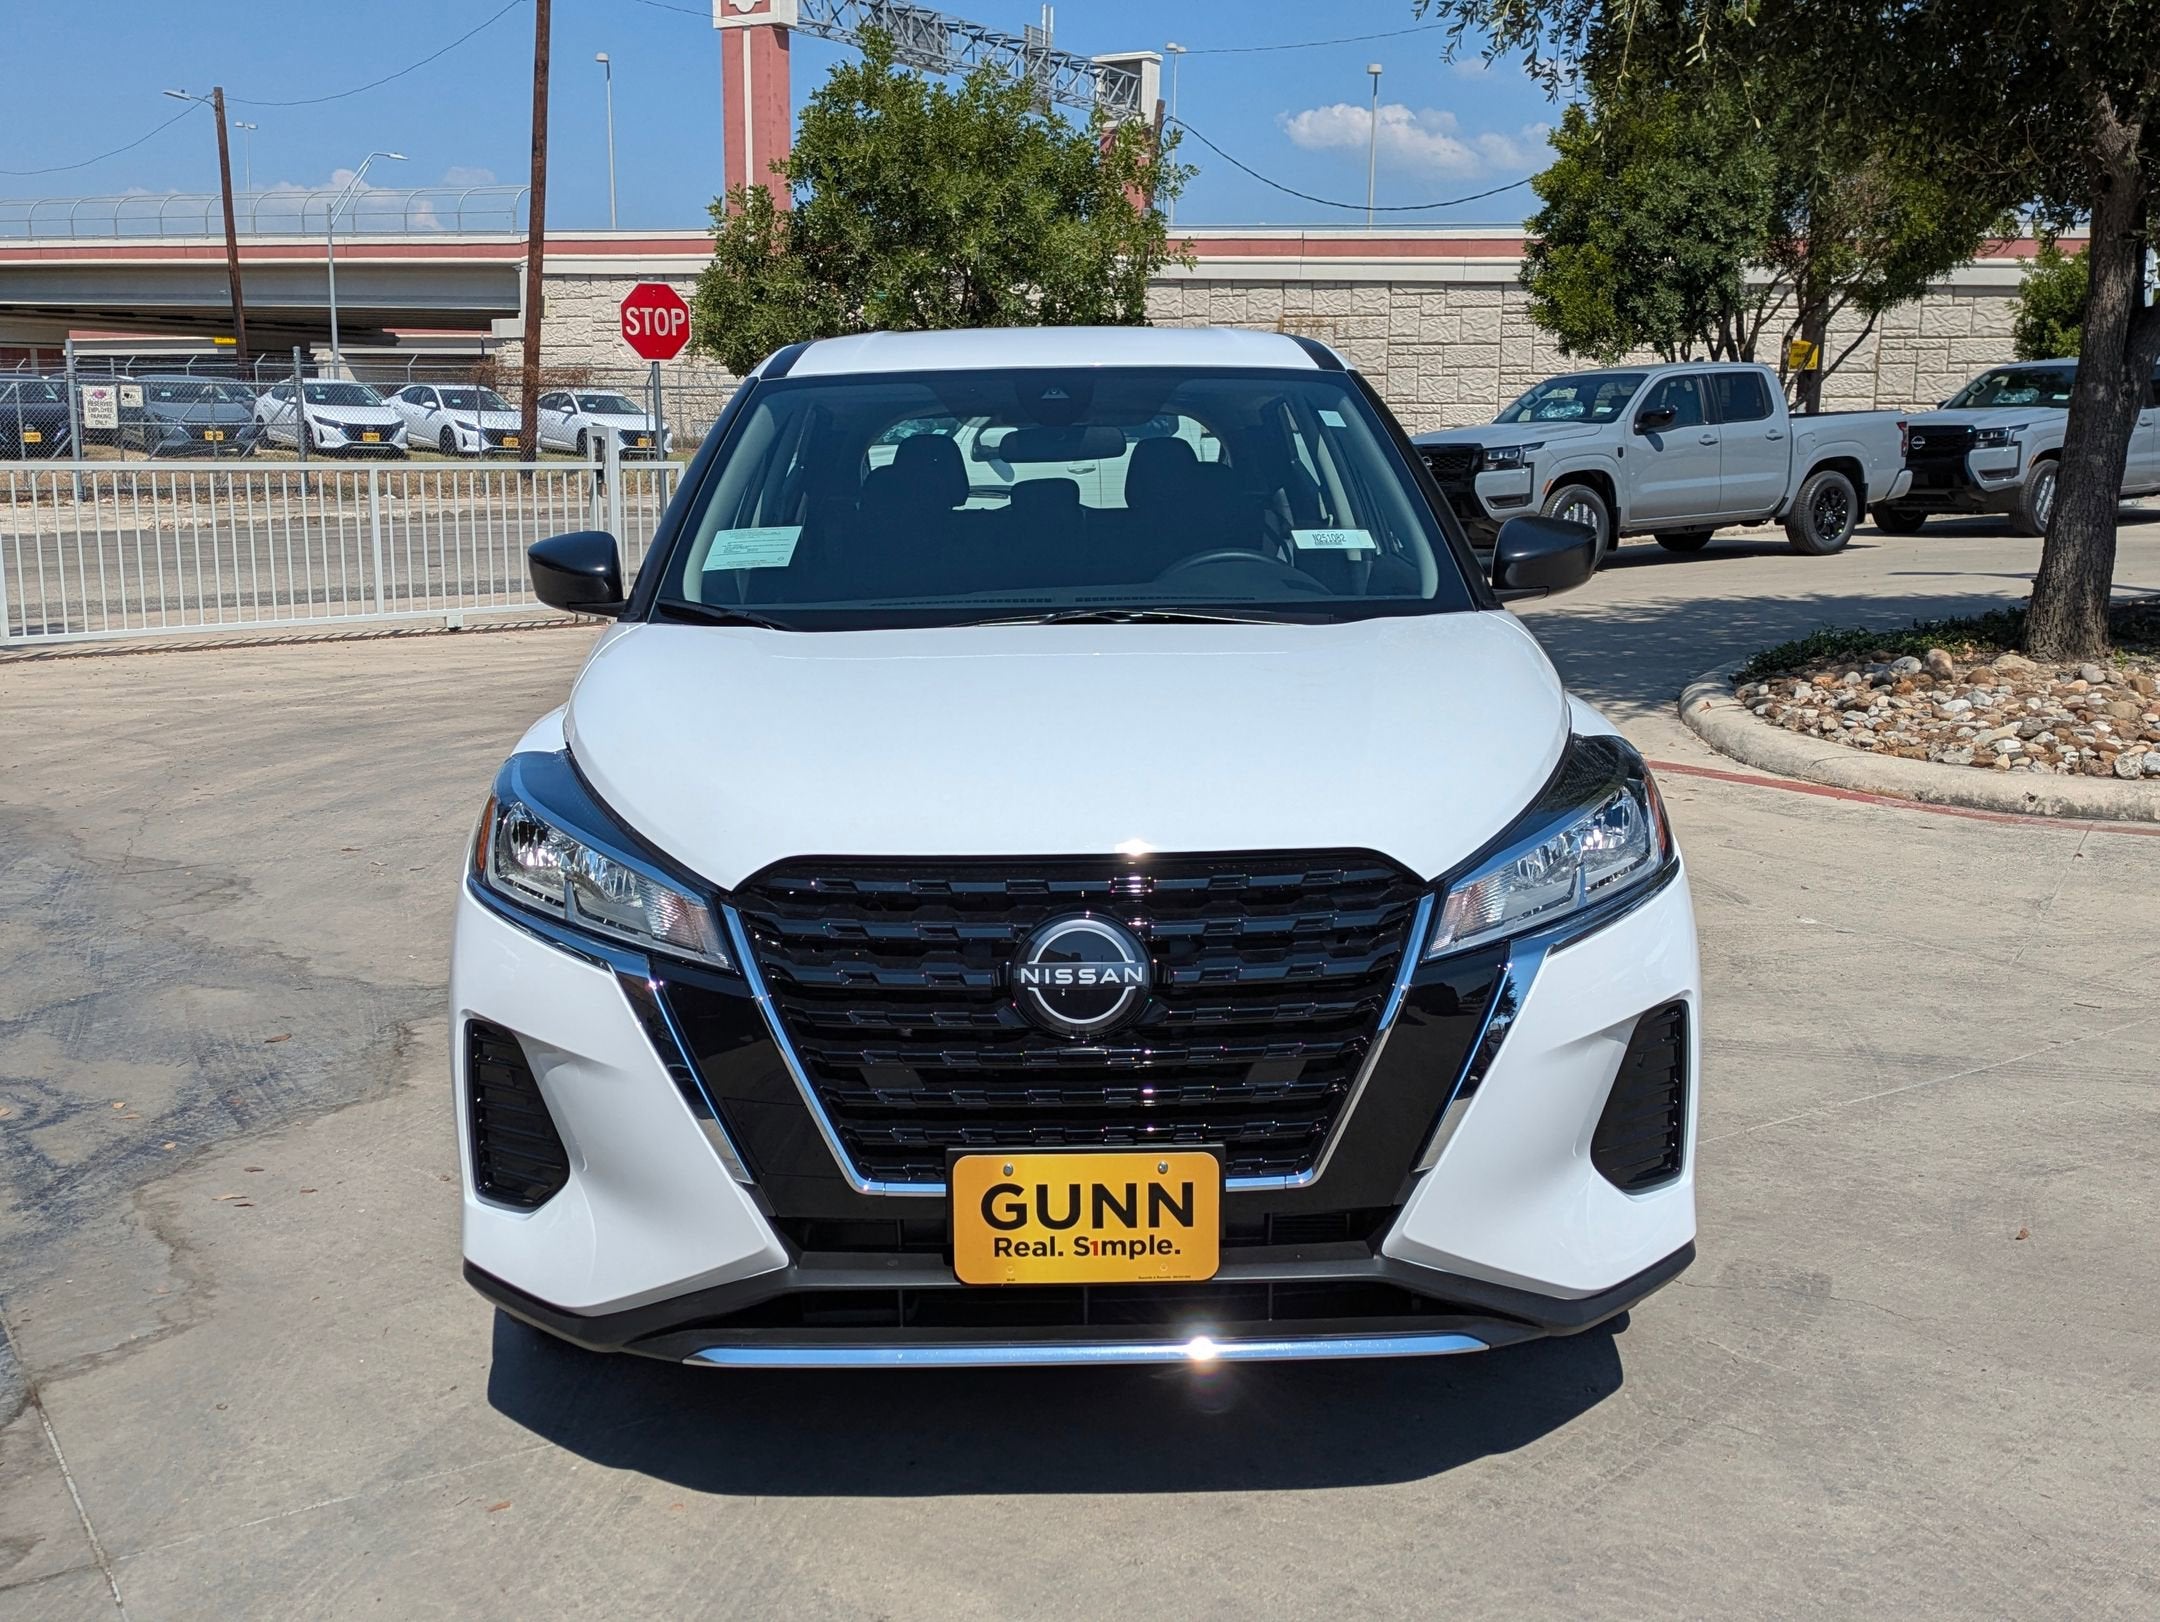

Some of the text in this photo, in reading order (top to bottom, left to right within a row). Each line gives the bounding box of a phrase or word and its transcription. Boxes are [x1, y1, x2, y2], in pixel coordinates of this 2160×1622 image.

[626, 307, 686, 336] STOP
[1020, 967, 1143, 985] NISSAN
[981, 1182, 1194, 1230] GUNN
[994, 1236, 1064, 1257] Real.
